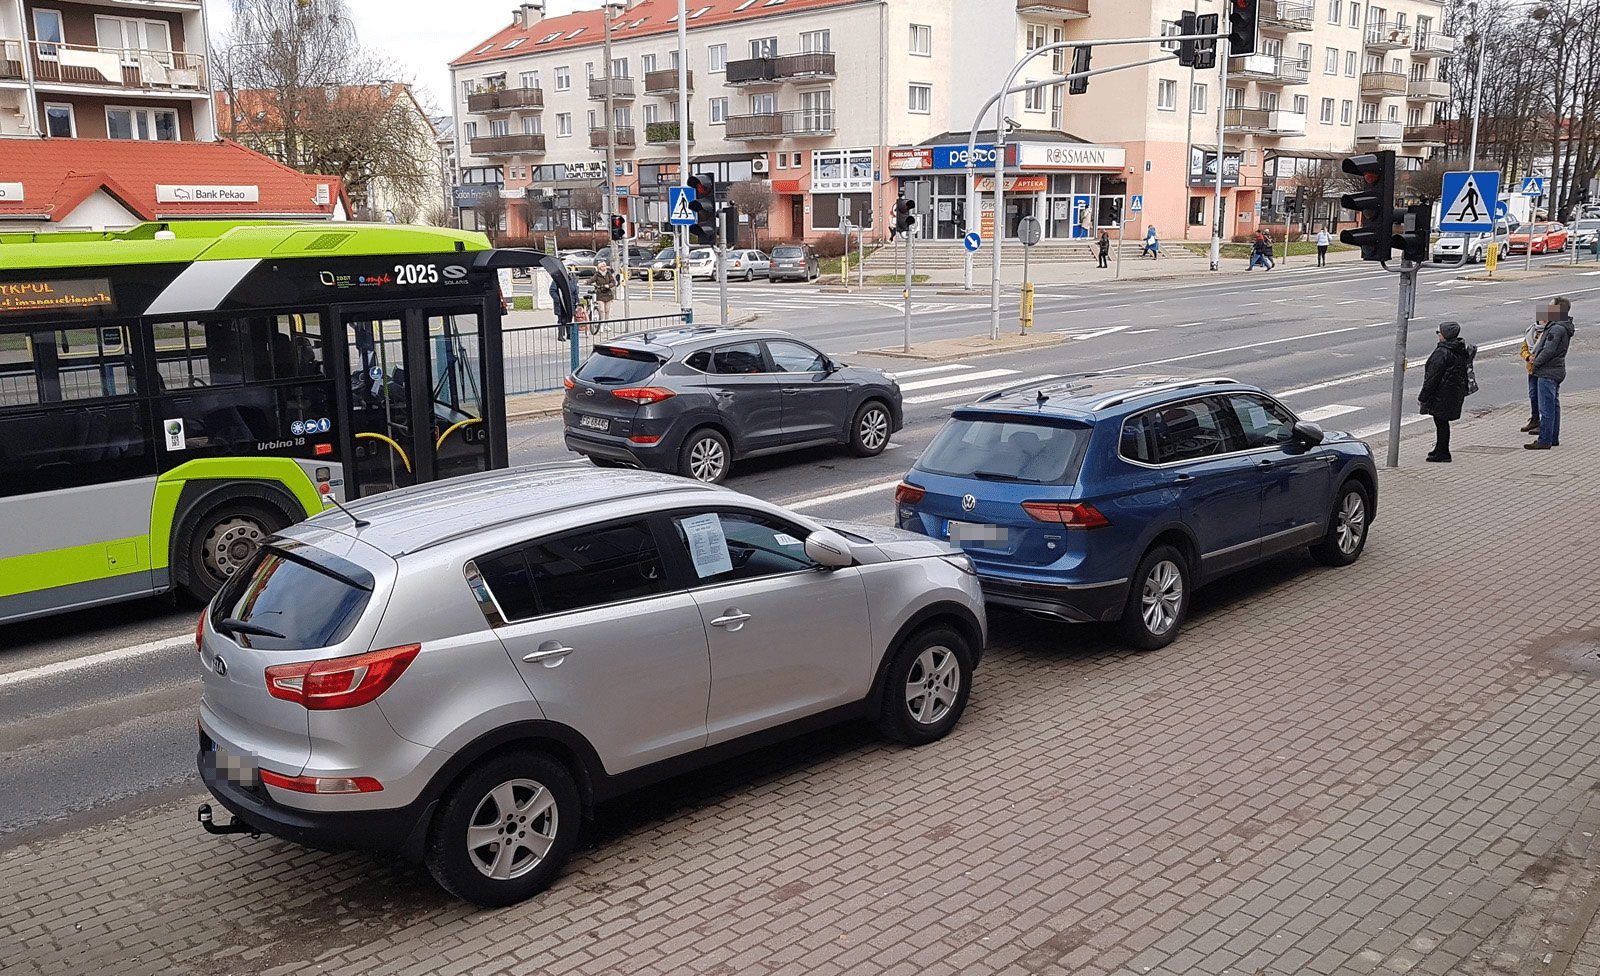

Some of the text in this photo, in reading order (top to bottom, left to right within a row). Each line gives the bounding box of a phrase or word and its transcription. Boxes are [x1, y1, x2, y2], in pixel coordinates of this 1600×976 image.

[1047, 149, 1104, 163] ROSSMANN
[195, 189, 246, 199] Bank Pekao
[394, 263, 439, 285] 2025
[258, 437, 305, 451] Urbino 18
